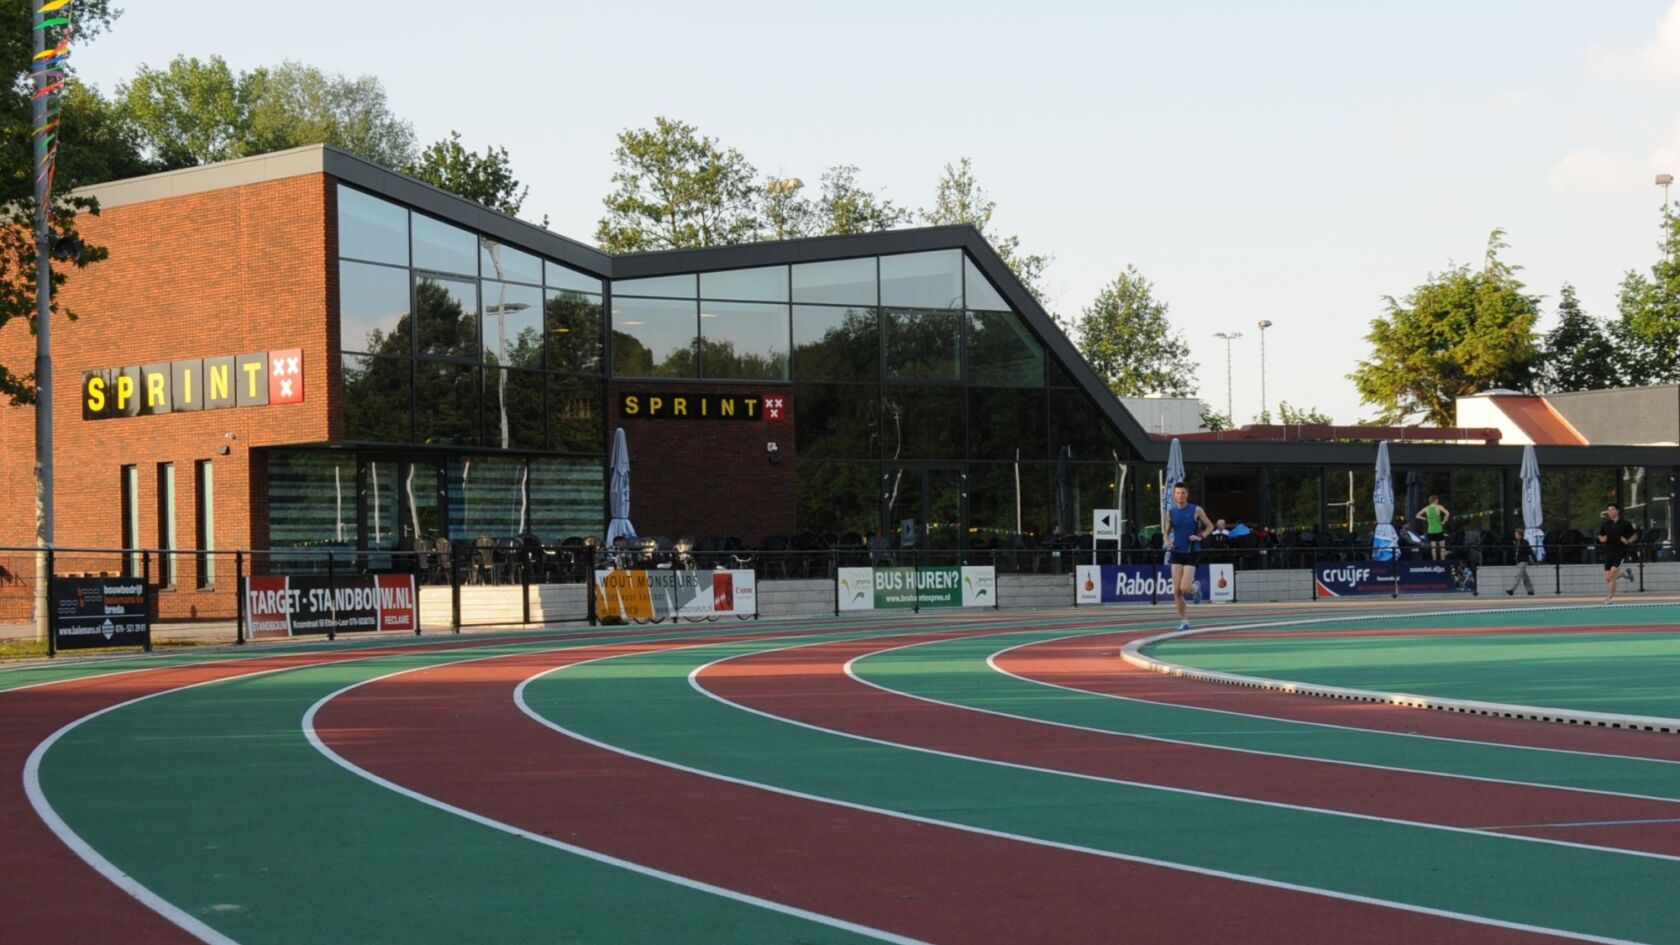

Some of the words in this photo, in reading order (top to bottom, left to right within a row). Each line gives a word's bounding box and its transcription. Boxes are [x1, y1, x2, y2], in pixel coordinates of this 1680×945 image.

[87, 362, 262, 412] SPRINT
[625, 396, 757, 417] SPRINT
[600, 575, 631, 588] WOUT
[875, 571, 903, 590] BUS
[906, 570, 959, 589] HUREN?
[1116, 571, 1175, 596] Raboba
[384, 614, 409, 625] RECLAME
